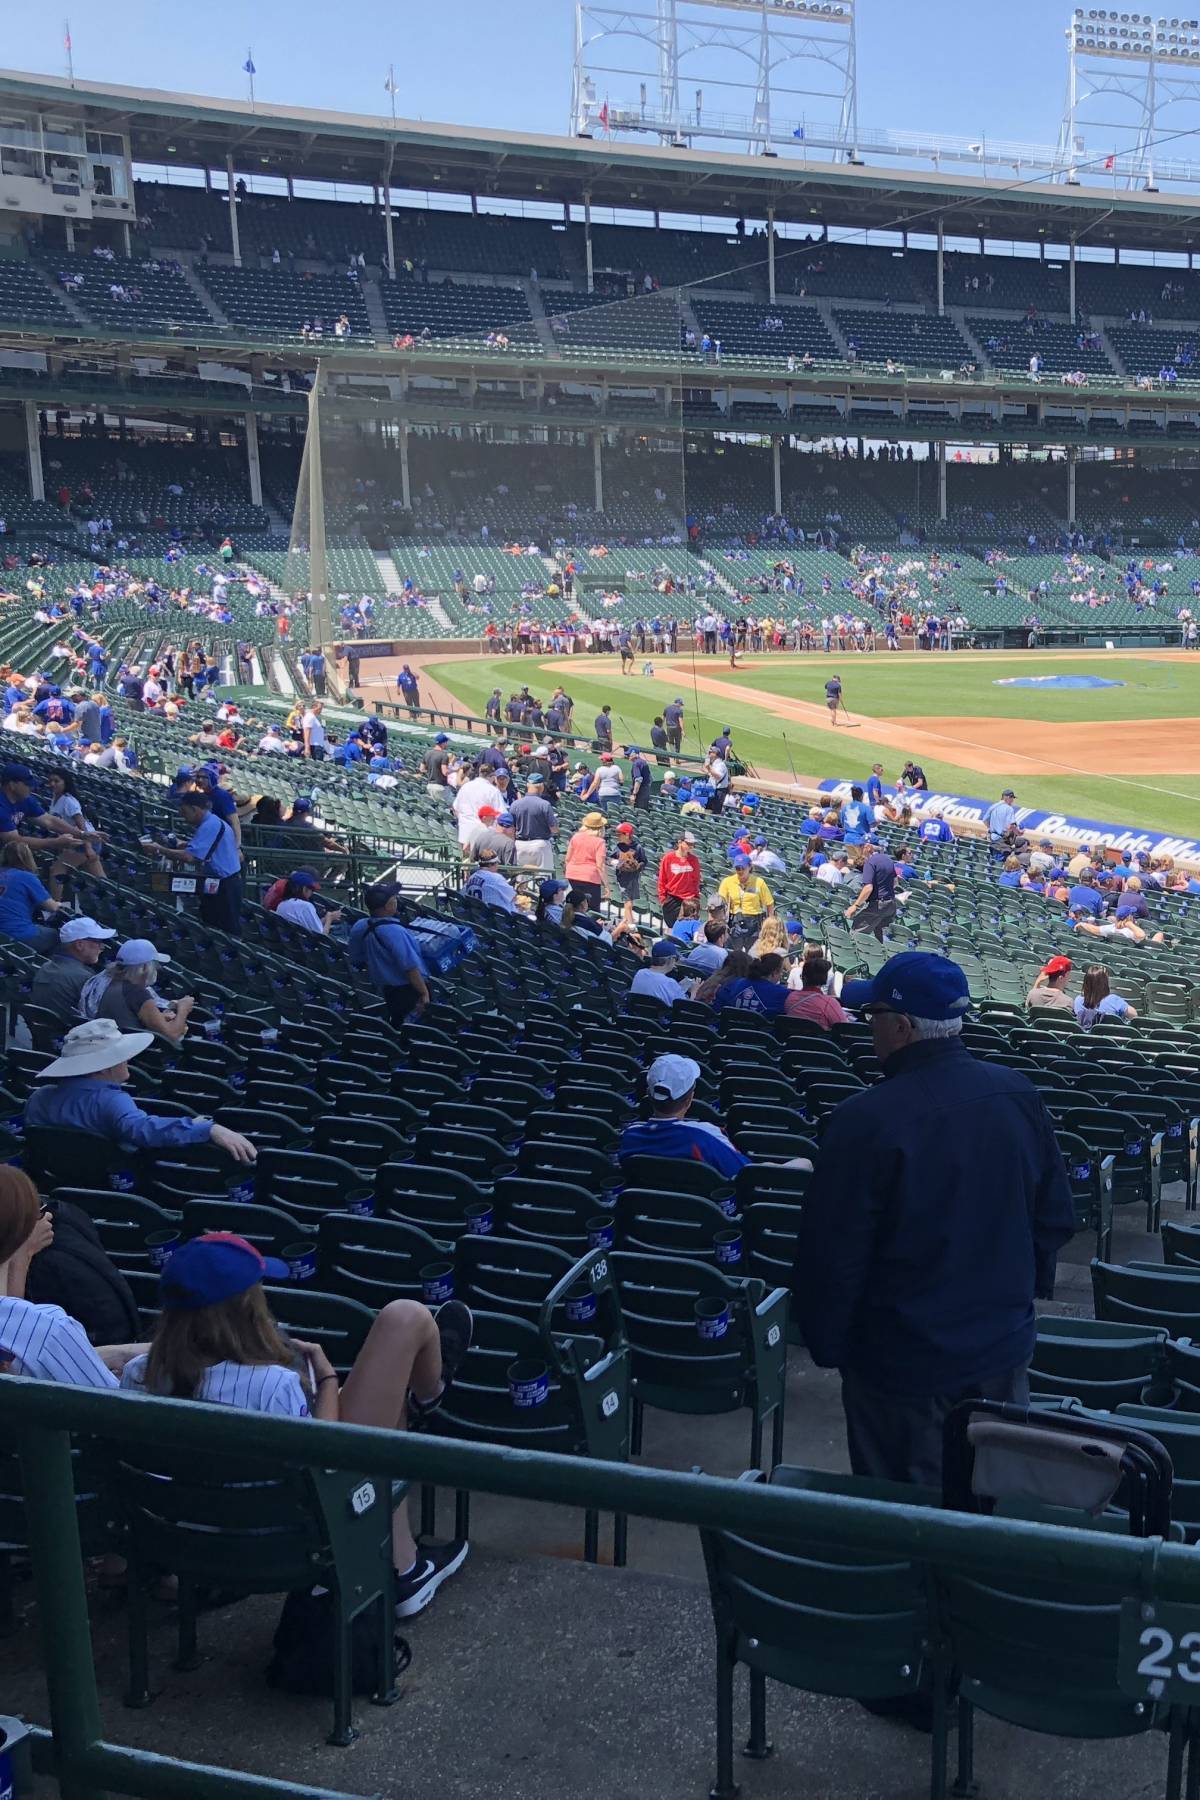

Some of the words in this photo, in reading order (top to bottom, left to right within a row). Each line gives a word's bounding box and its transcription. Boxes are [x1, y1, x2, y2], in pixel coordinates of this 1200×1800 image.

[923, 822, 942, 837] 23
[590, 1259, 608, 1283] 138
[356, 1487, 371, 1507] 15
